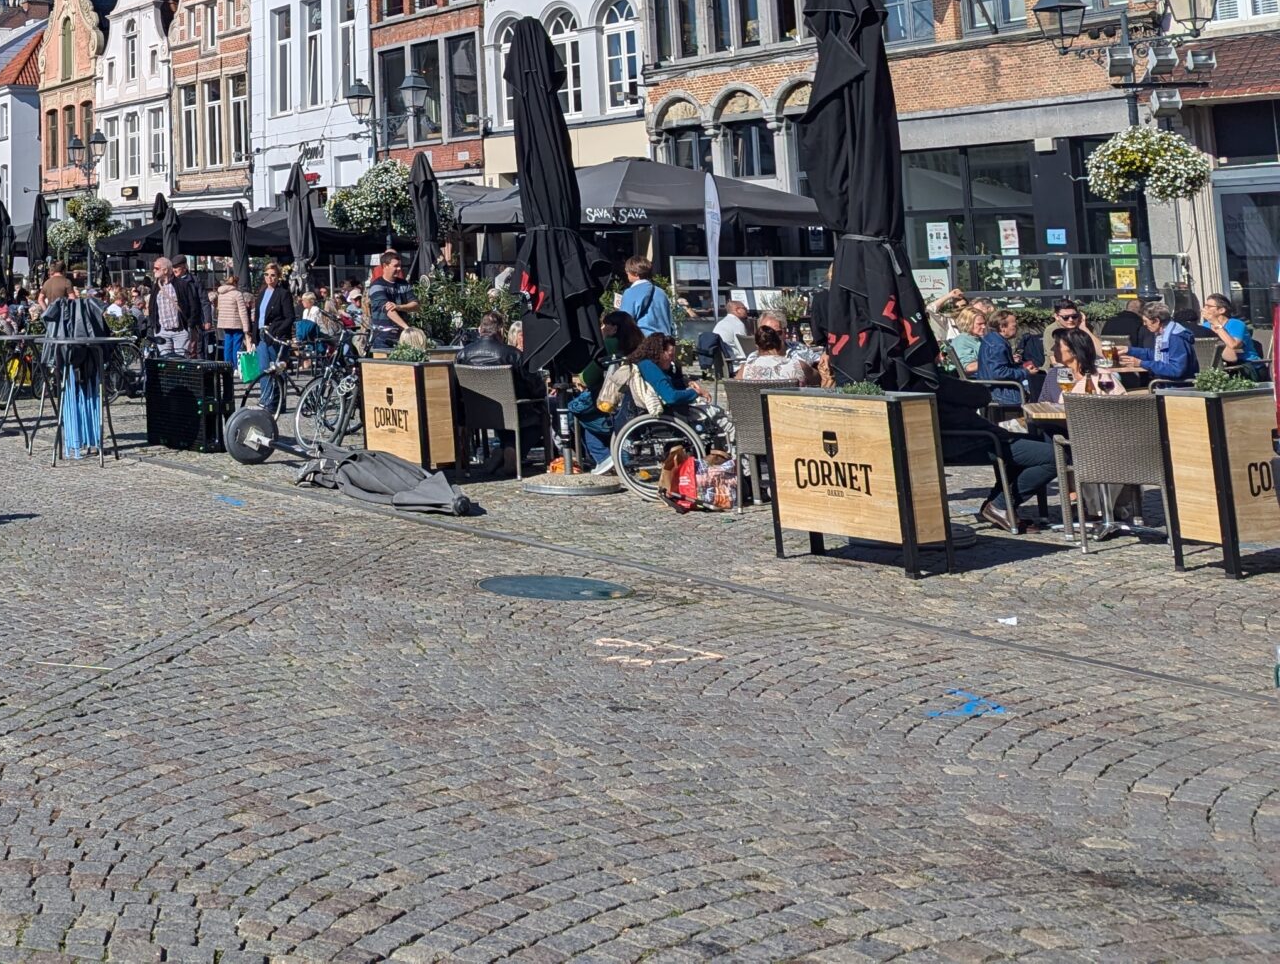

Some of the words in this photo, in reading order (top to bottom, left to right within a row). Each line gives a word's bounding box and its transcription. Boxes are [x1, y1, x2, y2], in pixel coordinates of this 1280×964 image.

[585, 208, 611, 223] SAVA
[618, 208, 648, 224] SAVA
[373, 406, 409, 432] CORNET
[794, 457, 873, 497] CORNET
[827, 489, 844, 497] OAKED
